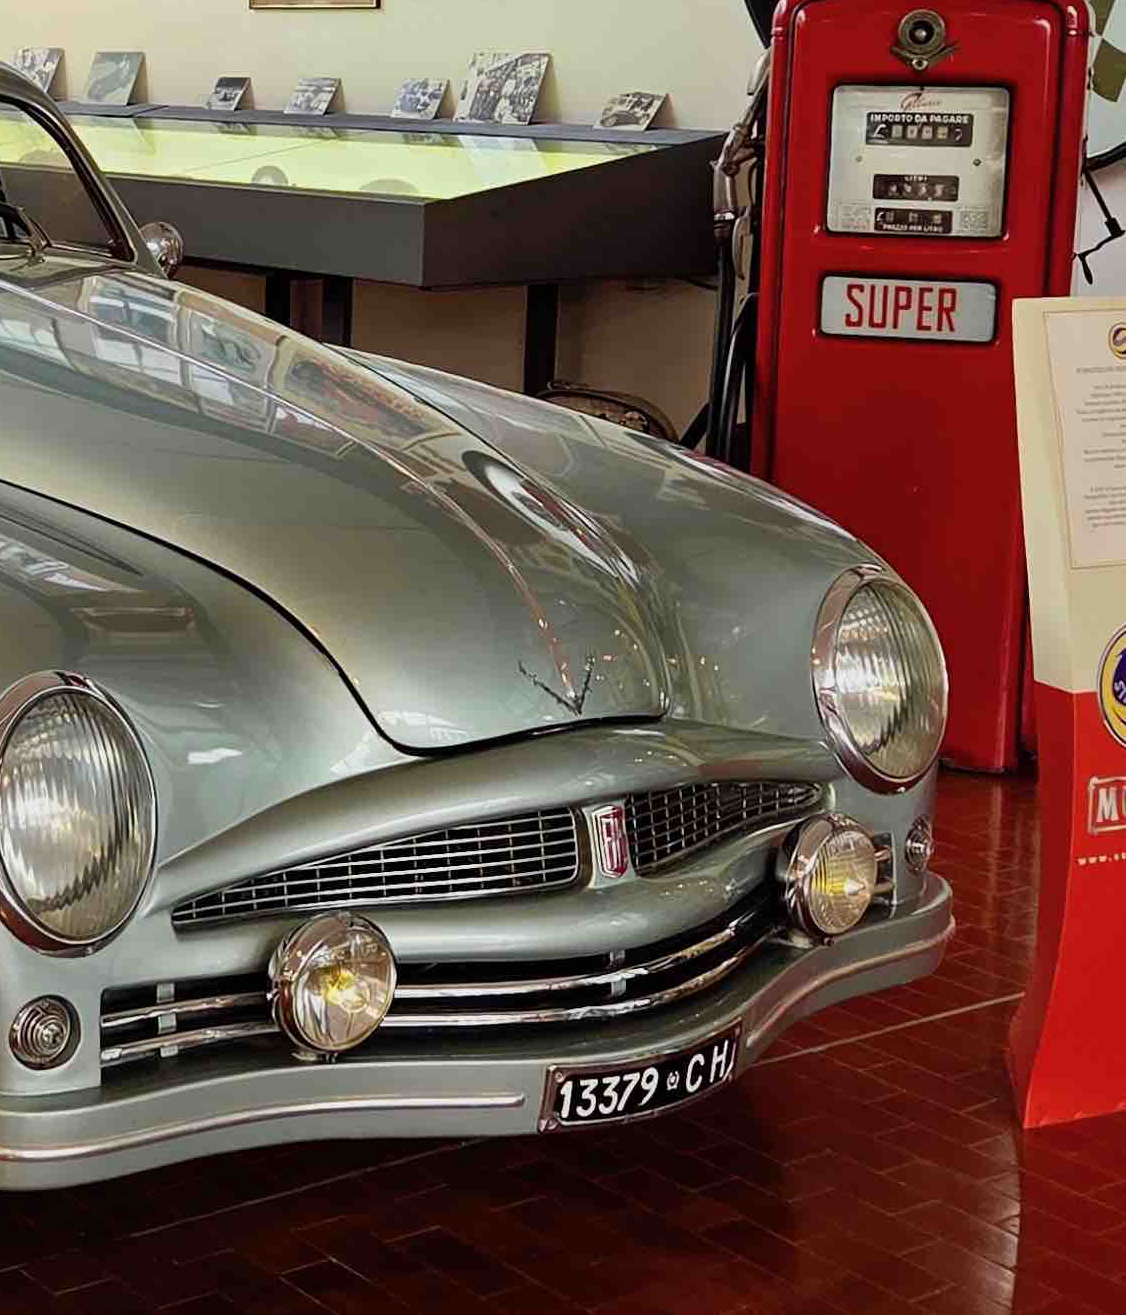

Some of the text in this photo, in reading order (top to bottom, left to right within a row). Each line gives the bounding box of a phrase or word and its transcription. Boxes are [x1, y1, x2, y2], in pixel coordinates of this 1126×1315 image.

[870, 113, 913, 123] IMPORTO
[930, 114, 970, 124] PAGARE
[845, 284, 957, 333] SUPER
[560, 1039, 729, 1119] 13379 CH
